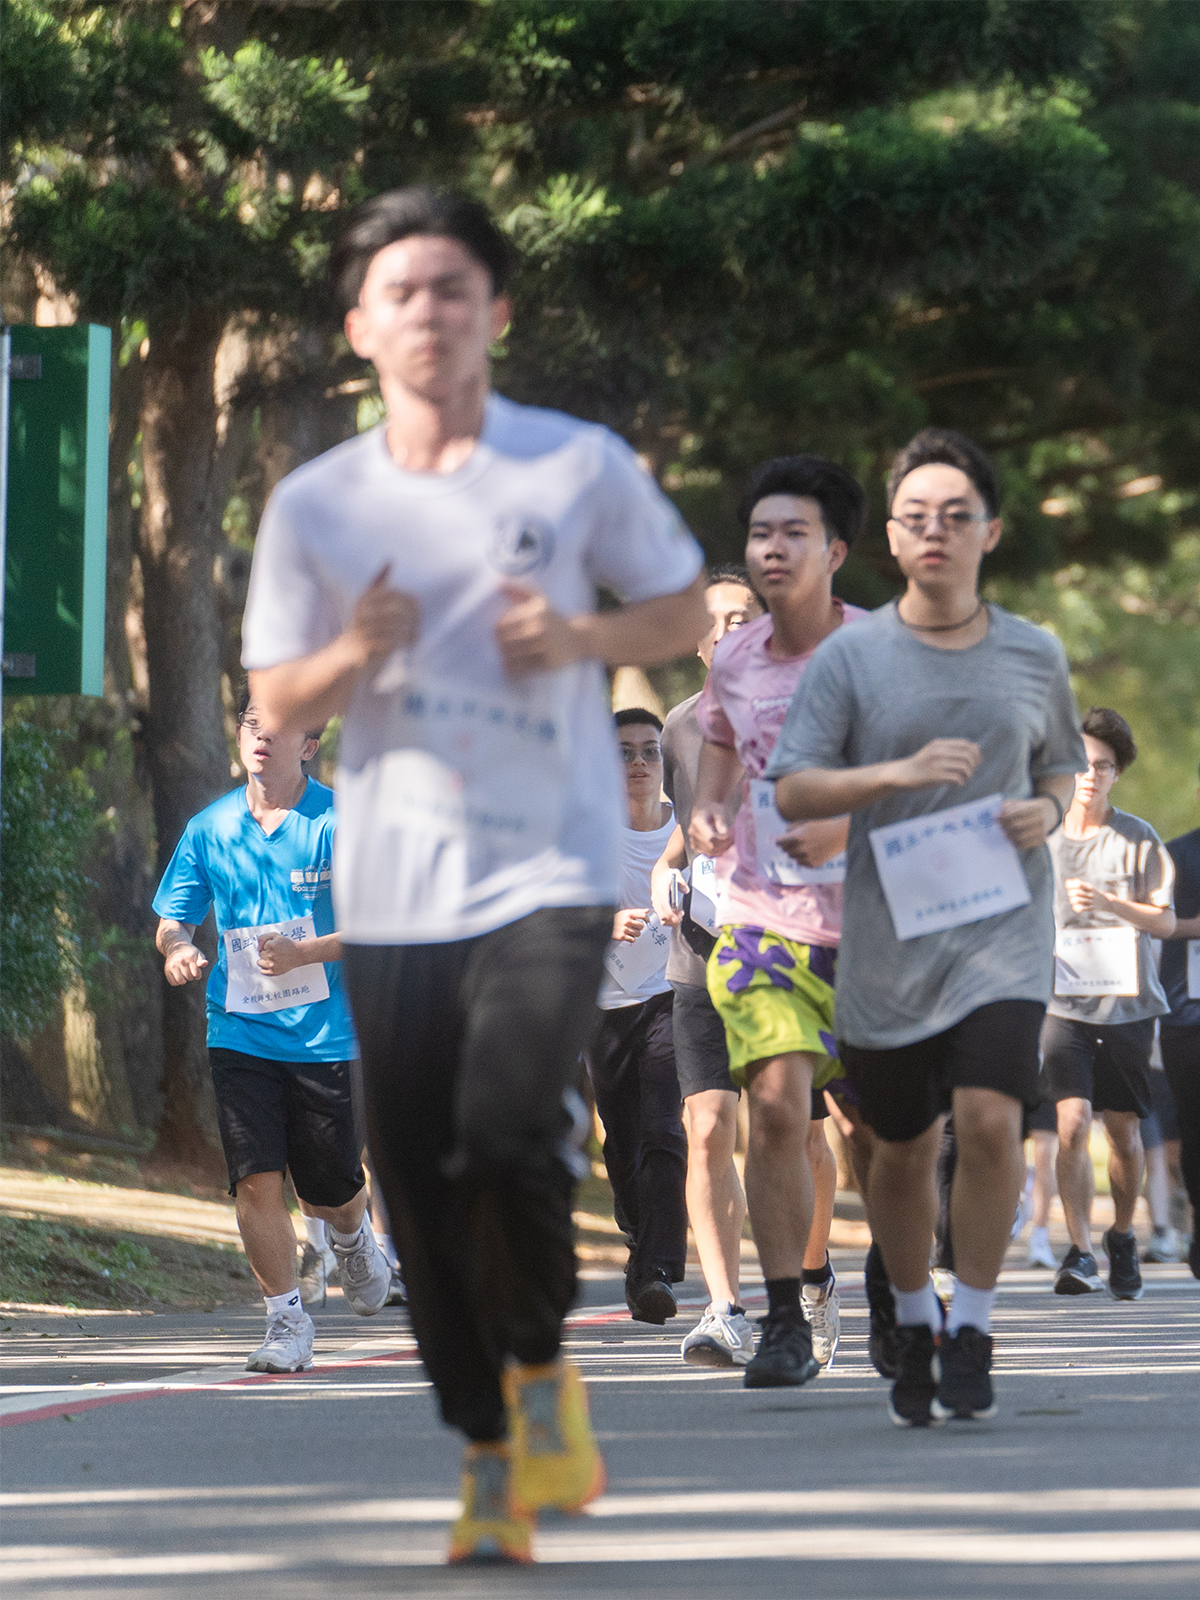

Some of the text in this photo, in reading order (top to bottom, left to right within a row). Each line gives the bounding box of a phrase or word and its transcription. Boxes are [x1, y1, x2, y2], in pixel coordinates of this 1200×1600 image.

[241, 984, 311, 1005] 全校師生校園路跑
